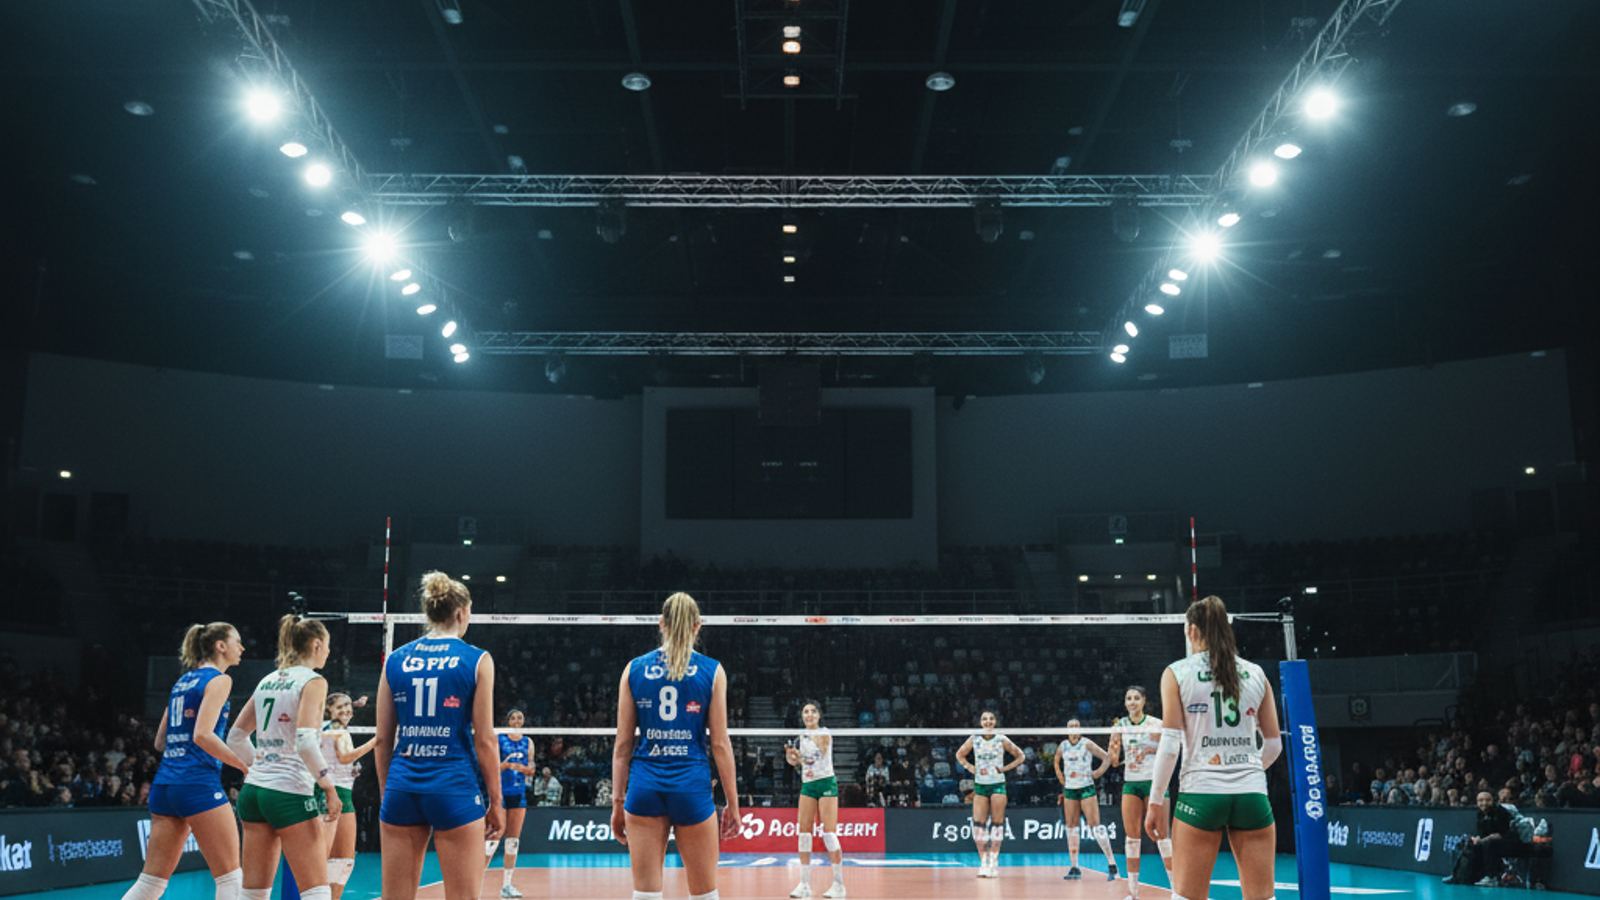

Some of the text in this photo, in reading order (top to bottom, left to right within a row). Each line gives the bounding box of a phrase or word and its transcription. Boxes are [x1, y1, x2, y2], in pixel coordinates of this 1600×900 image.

[262, 698, 275, 731] 7
[412, 677, 438, 717] 11
[658, 685, 678, 722] 8
[1210, 690, 1241, 728] 13
